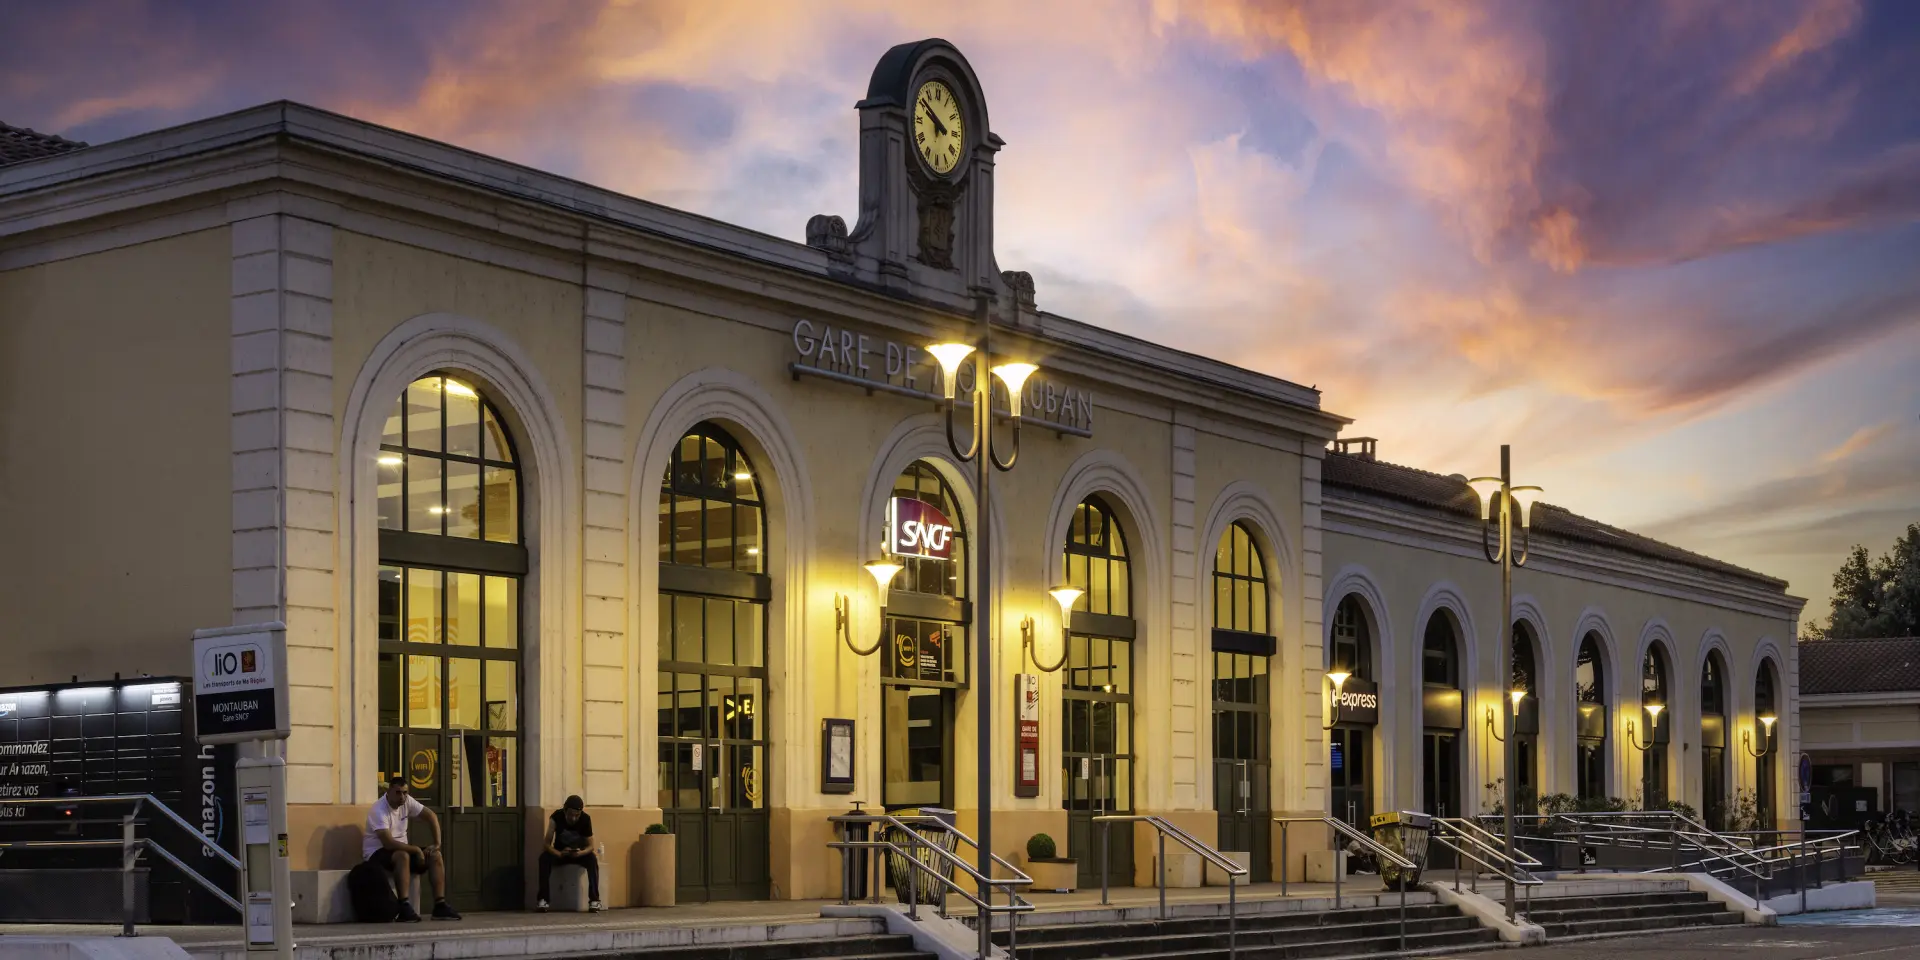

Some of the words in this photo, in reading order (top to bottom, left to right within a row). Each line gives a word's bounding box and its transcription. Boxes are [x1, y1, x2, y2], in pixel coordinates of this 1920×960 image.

[793, 319, 870, 371] GARE
[886, 342, 917, 381] DE
[900, 520, 952, 551] SNCF
[212, 679, 235, 688] transports
[250, 677, 266, 686] Région
[212, 700, 259, 714] MONTAUBAN
[1341, 692, 1377, 711] express
[222, 714, 235, 722] Gare
[235, 712, 250, 721] SNCF
[415, 763, 428, 771] WIFI
[23, 786, 39, 796] vos
